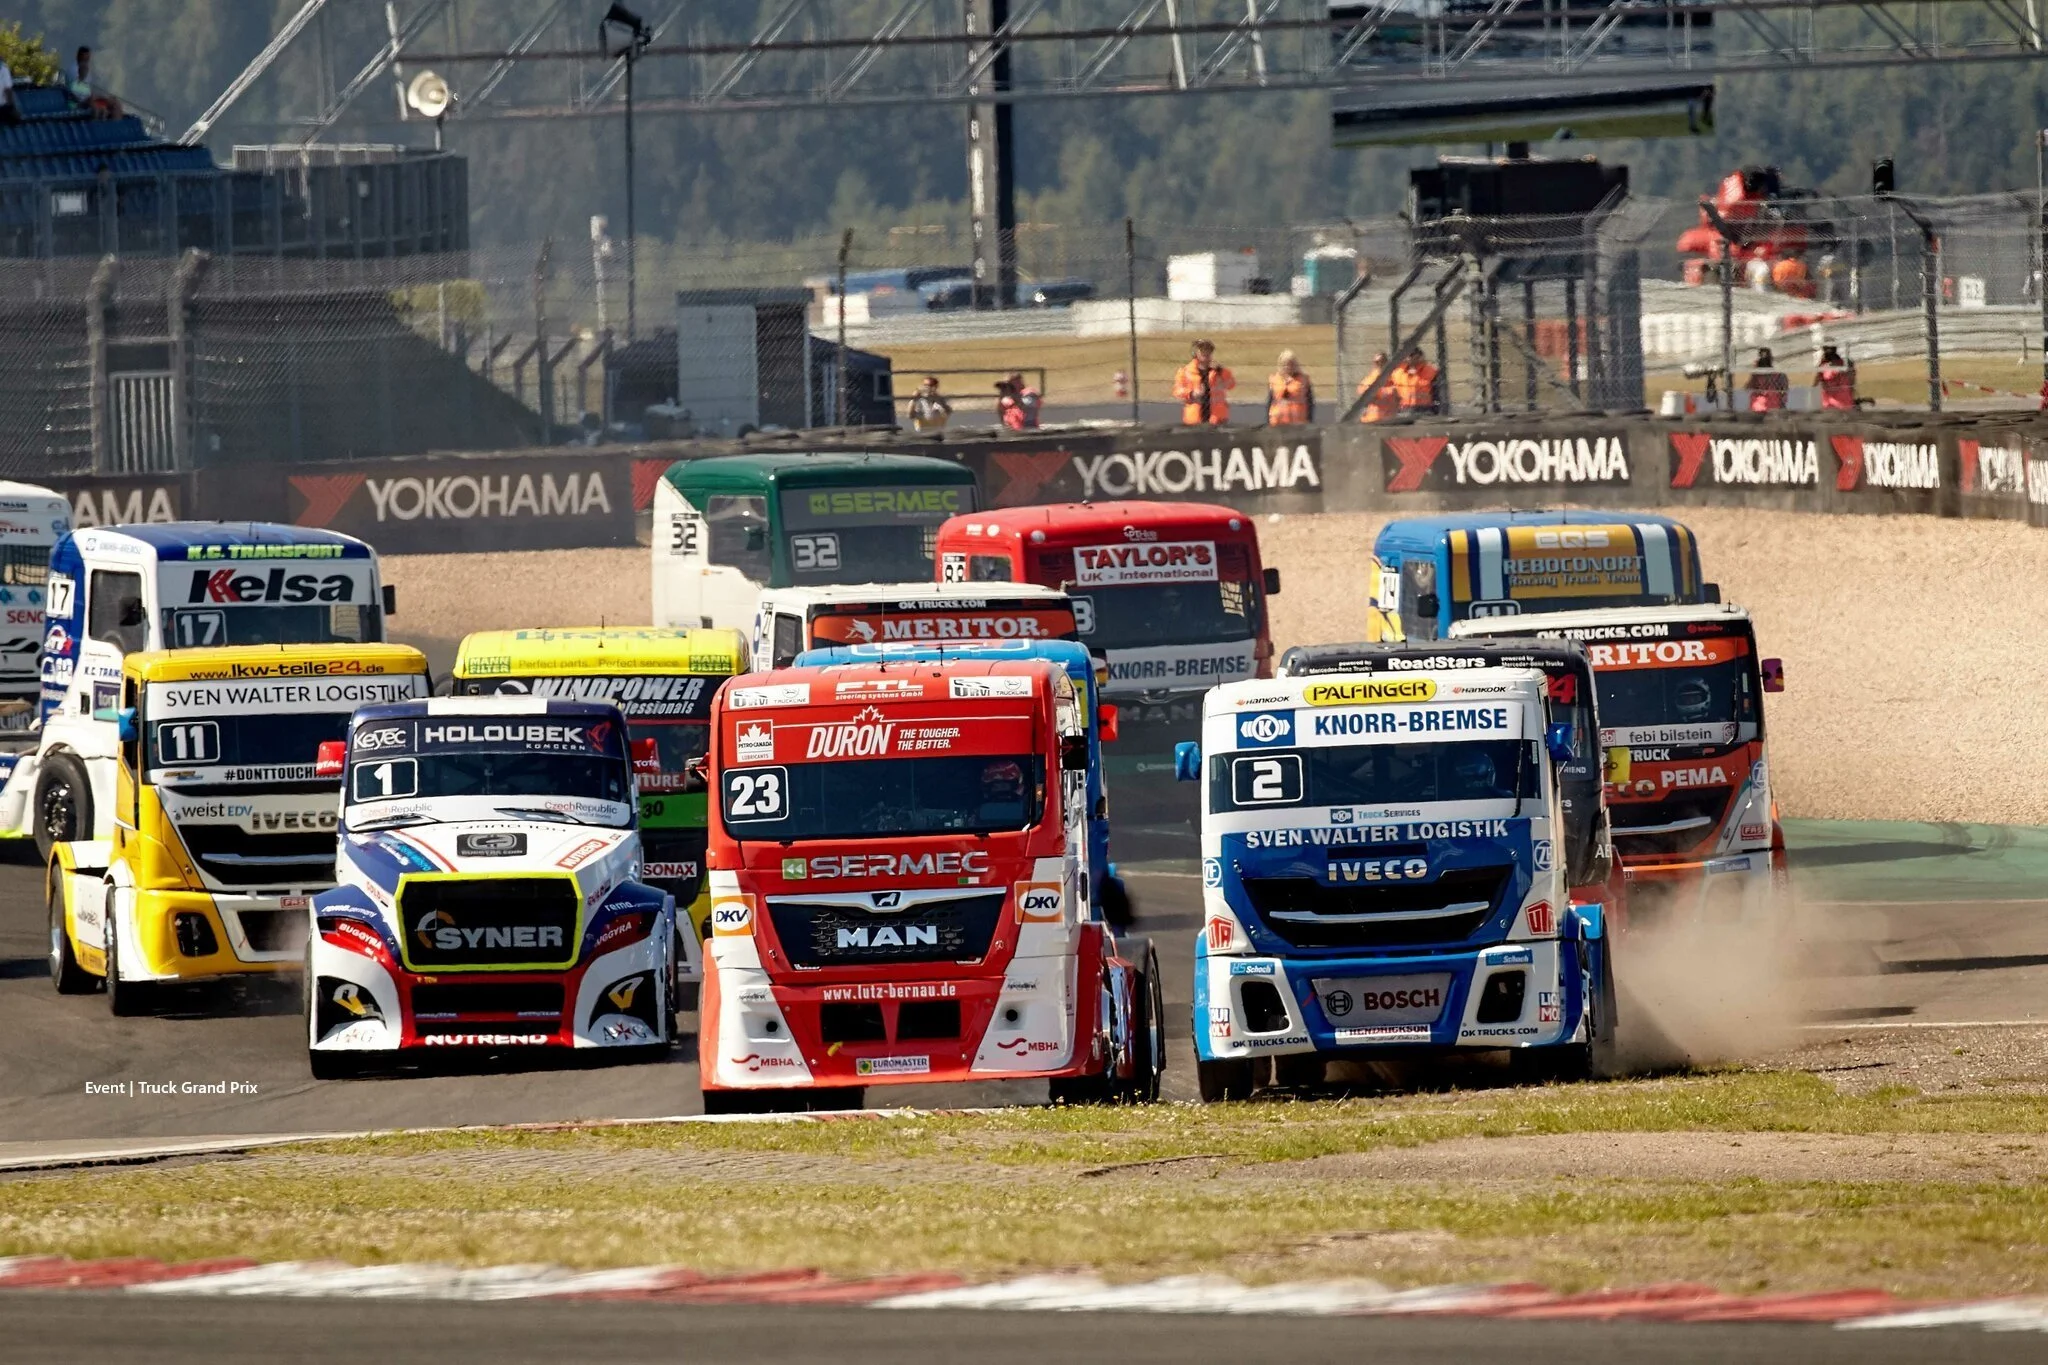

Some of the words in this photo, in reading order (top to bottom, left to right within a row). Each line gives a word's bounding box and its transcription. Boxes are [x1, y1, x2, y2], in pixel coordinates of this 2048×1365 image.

[1073, 445, 1320, 498] YOKOHAMA
[1447, 437, 1630, 484] YOKOHAMA
[1709, 439, 1819, 484] YOKOHAMA
[366, 470, 612, 522] YOKOHAMA
[831, 490, 960, 513] SERMEC
[671, 523, 698, 550] 32
[187, 544, 225, 560] K.C.
[229, 544, 344, 559] TRANSPORT
[795, 537, 838, 568] 32
[1079, 545, 1213, 570] TAYLOR'S
[1081, 573, 1103, 582] UK
[1120, 569, 1213, 580] International
[1503, 556, 1644, 575] REBOCONORT
[52, 583, 70, 611] 17
[188, 568, 354, 604] Kelsa
[919, 599, 987, 609] TRUCKS.COM
[181, 613, 221, 646] 17
[882, 617, 1041, 639] MERITOR
[1564, 624, 1669, 640] TRUCKS.COM
[469, 656, 510, 665] MANN
[690, 655, 730, 664] MANN
[1387, 656, 1486, 670] RoadStars
[1589, 641, 1708, 666] RITOR
[190, 660, 384, 680] www.lkw-teile24.de
[1109, 656, 1246, 680] KNORR-BREMSE
[166, 688, 221, 707] SVEN
[226, 685, 310, 705] WALTER
[316, 684, 412, 703] LOGISTIK
[530, 678, 705, 701] WINDPOWER
[836, 680, 924, 692] FTL
[836, 693, 867, 701] steering
[868, 692, 900, 700] systems
[1313, 682, 1428, 701] PALFINGER
[1546, 673, 1577, 703] 4
[1315, 708, 1508, 736] KNORR-BREMSE
[171, 725, 205, 760] 11
[425, 725, 584, 743] HOLOUBEK
[806, 723, 893, 759] DURON
[897, 740, 914, 751] THE
[914, 738, 952, 750] BETTER.
[899, 730, 917, 740] THE
[918, 728, 961, 739] TOUGHER.
[1629, 730, 1656, 744] febi
[1660, 727, 1712, 742] bilstein
[374, 763, 393, 796] 1
[1252, 760, 1283, 799] 2
[1661, 766, 1728, 788] PEMA
[730, 773, 781, 817] 23
[182, 802, 225, 818] weist
[228, 805, 253, 818] EDV
[252, 810, 337, 830] IVECO
[642, 800, 665, 819] 30
[1246, 830, 1303, 850] SVEN
[1309, 825, 1399, 846] WALTER
[1407, 819, 1508, 842] LOGISTIK
[643, 863, 695, 877] SONAX
[811, 850, 988, 879] SERMEC
[1328, 858, 1428, 882] IVECO
[1023, 896, 1060, 909] DKV
[715, 909, 750, 924] DKV
[435, 925, 563, 950] SYNER
[836, 925, 938, 948] MAN
[823, 981, 957, 1001] www.lutz-bernau.de
[1363, 988, 1441, 1011] BOSCH
[424, 1033, 549, 1046] NUTREND
[1232, 1040, 1246, 1049] OK
[1248, 1037, 1309, 1048] TRUCKS.COM
[1461, 1029, 1476, 1038] OK
[1477, 1027, 1539, 1037] TRUCKS.COM
[1028, 1041, 1060, 1052] MBHA
[760, 1057, 795, 1068] MBHA
[873, 1057, 928, 1068] EUROMASTER
